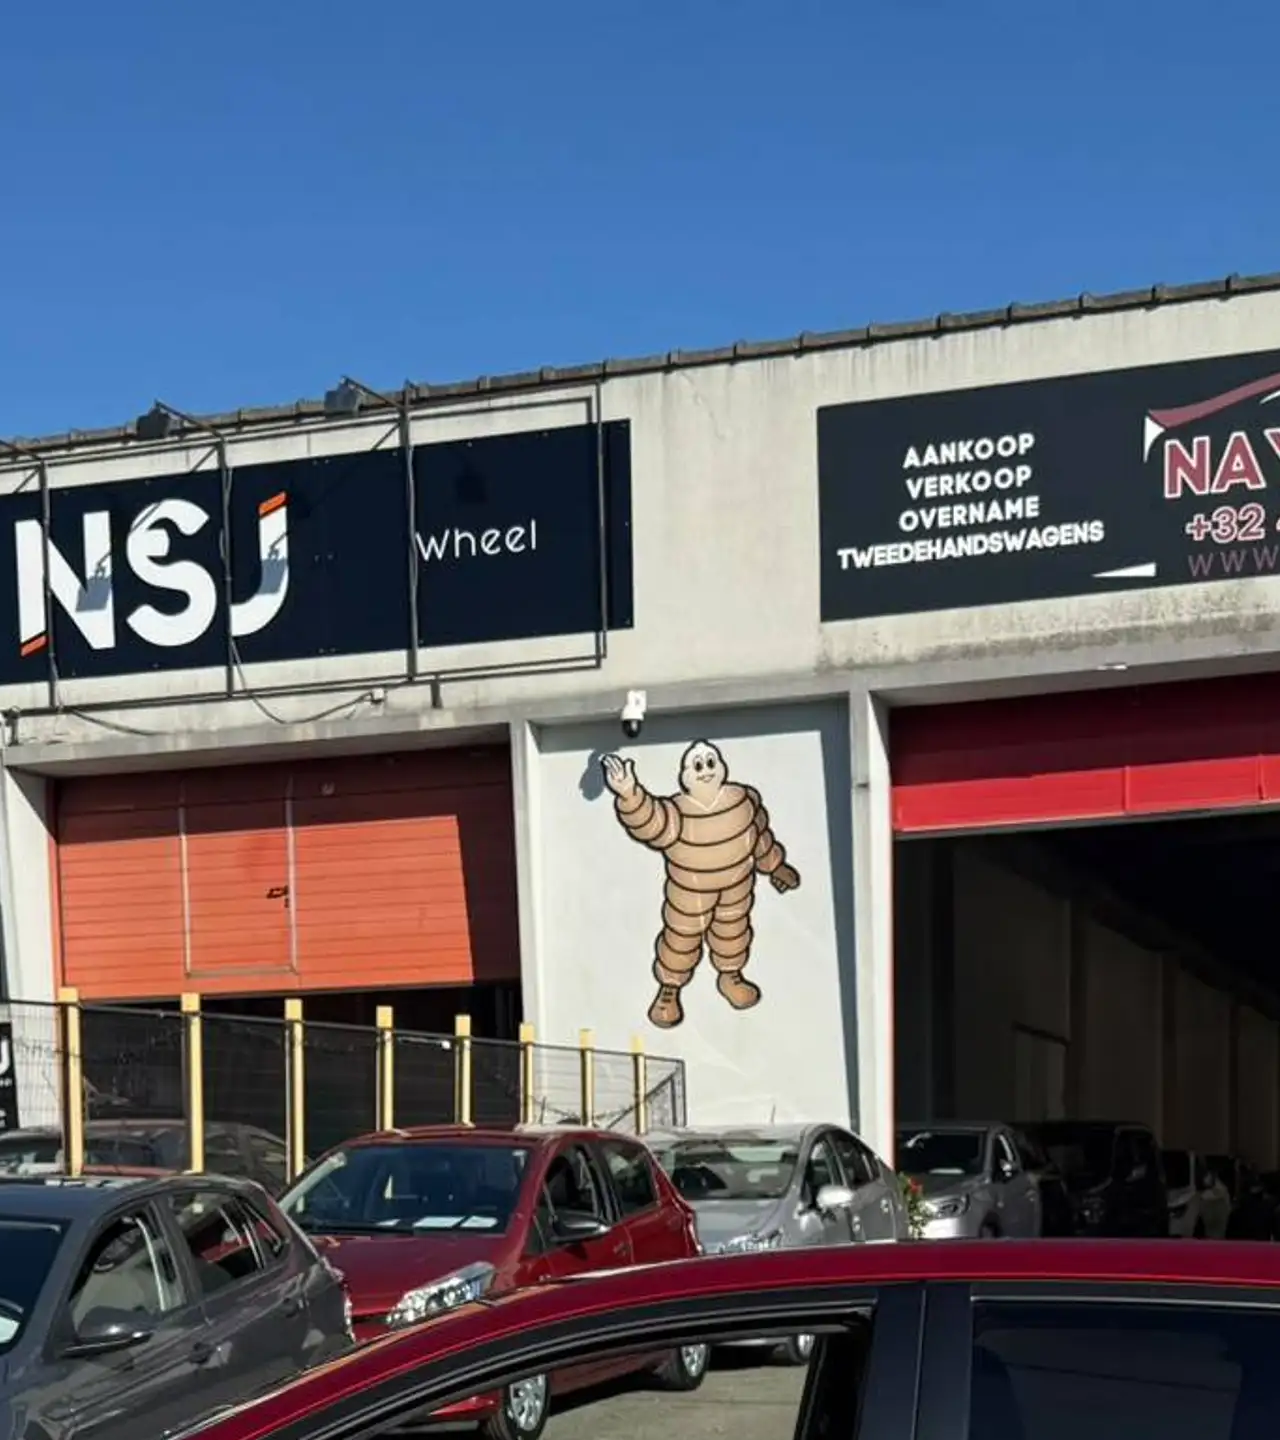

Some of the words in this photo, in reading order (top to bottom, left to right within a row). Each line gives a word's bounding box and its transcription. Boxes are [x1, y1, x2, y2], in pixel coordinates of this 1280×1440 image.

[903, 433, 1035, 469] AANKOOP
[905, 465, 1032, 500] VERKOOP
[898, 495, 1040, 532] OVERNAME
[1185, 503, 1265, 543] +32
[837, 520, 1105, 570] TWEEDEHANDSWAGENS
[14, 491, 290, 657] NSJ
